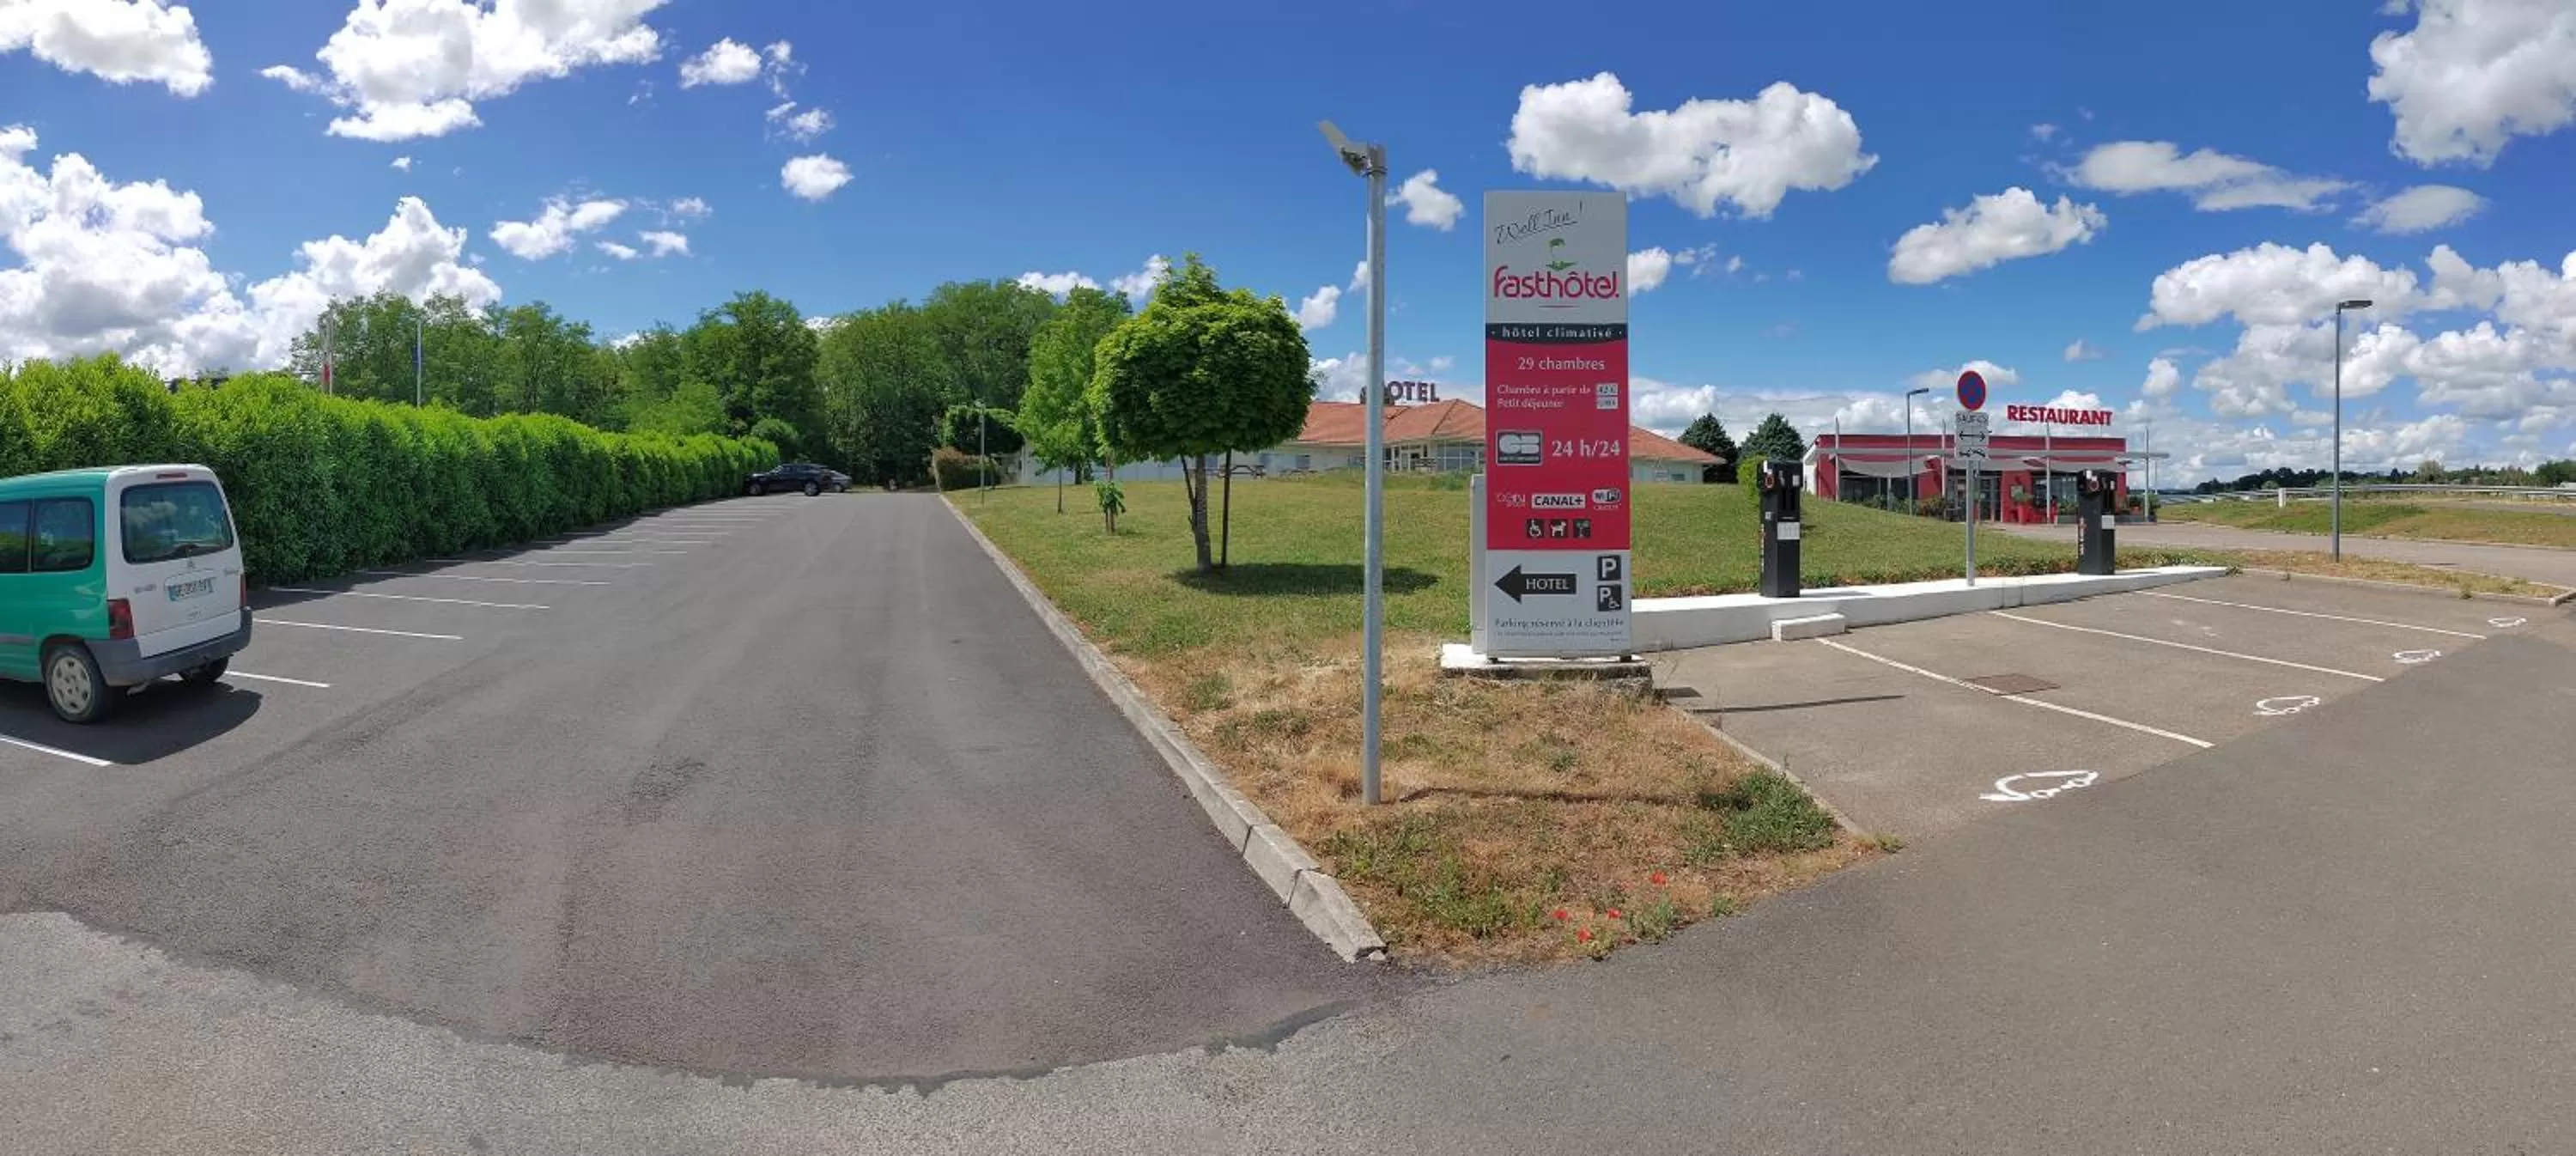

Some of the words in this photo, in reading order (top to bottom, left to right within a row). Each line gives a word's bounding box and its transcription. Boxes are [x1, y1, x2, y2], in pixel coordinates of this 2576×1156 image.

[1503, 327, 1540, 338] hôtel
[1546, 327, 1613, 338] climatisé
[1517, 357, 1534, 370] 29
[1538, 357, 1606, 371] chambres
[1374, 380, 1440, 402] OTEL
[1498, 384, 1541, 394] Chambre
[2007, 405, 2113, 426] RESTAURANT
[1552, 440, 1574, 456] 24
[1579, 439, 1621, 457] h/24
[1534, 496, 1584, 506] CANAL+
[1602, 558, 1616, 578] P
[1526, 578, 1570, 590] HOTEL
[1600, 587, 1611, 602] P
